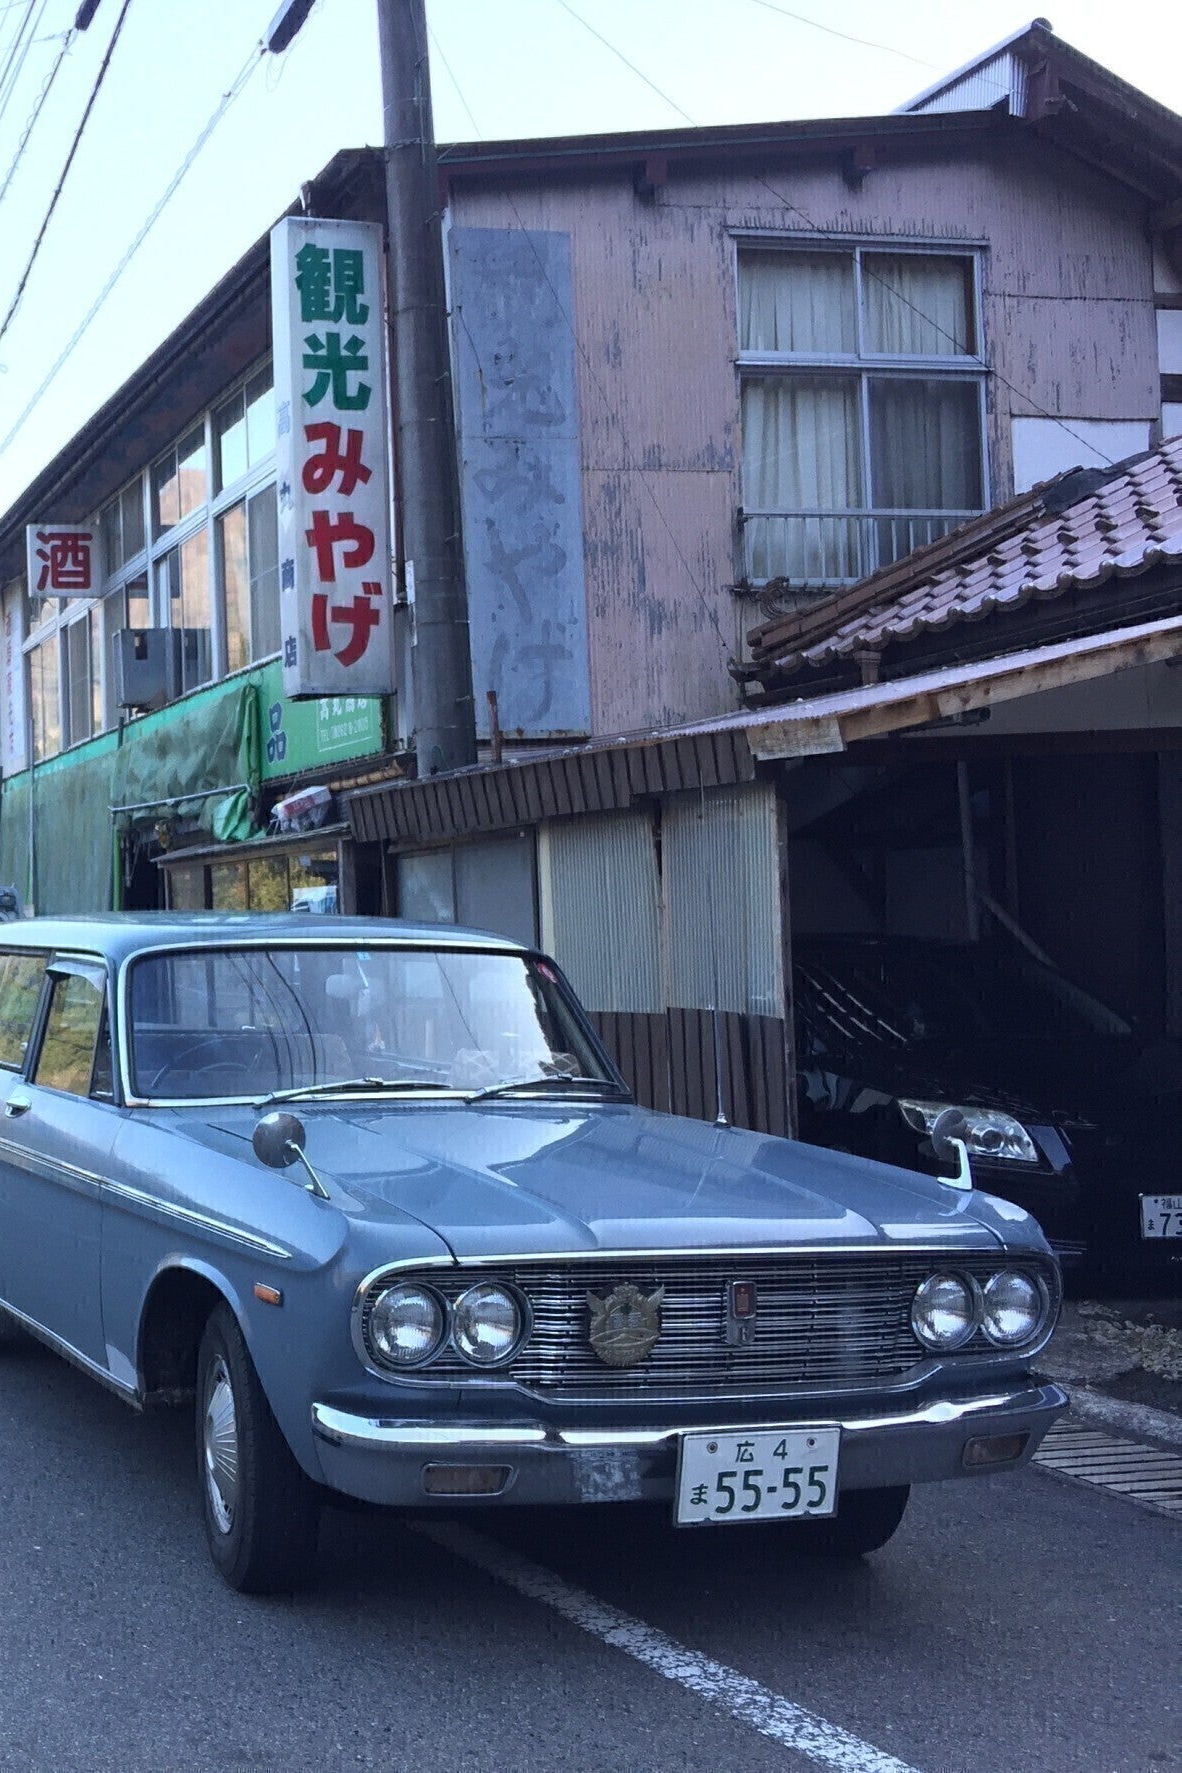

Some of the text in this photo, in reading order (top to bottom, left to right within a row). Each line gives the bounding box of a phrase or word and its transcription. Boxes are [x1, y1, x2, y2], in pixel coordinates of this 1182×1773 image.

[295, 243, 382, 668] 観光みやげ
[36, 531, 93, 592] 酒
[735, 1438, 788, 1463] 広 4
[690, 1465, 829, 1514] ま 55-55
